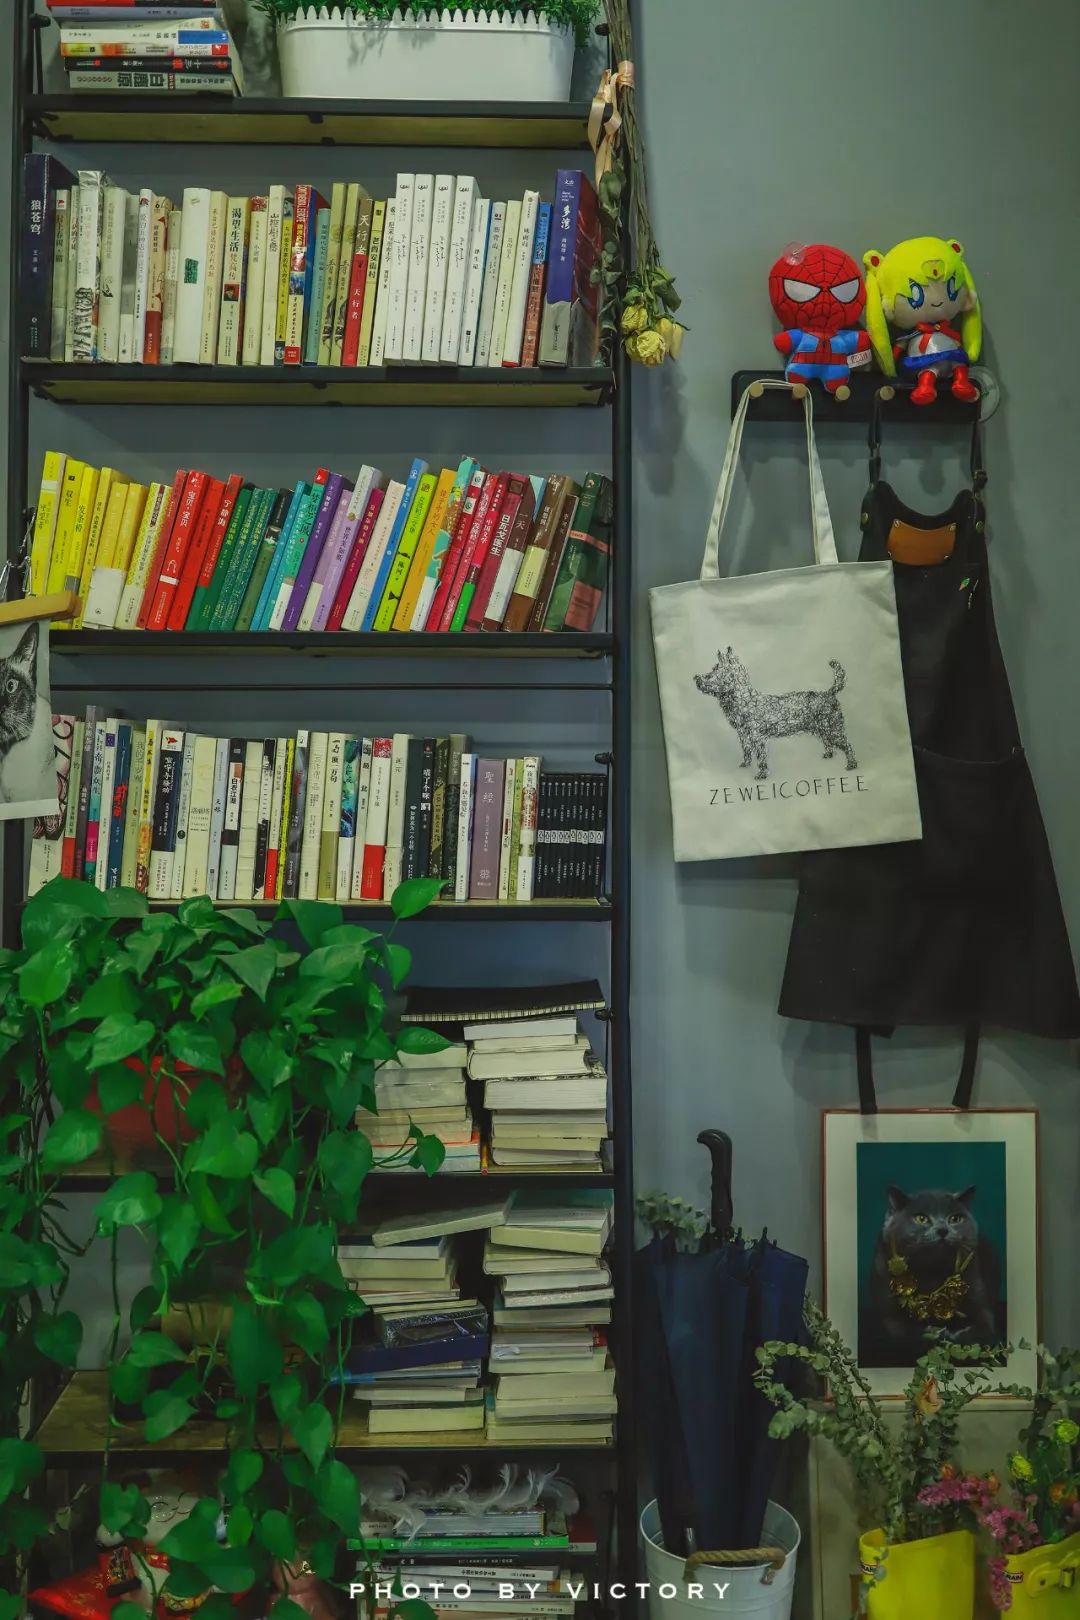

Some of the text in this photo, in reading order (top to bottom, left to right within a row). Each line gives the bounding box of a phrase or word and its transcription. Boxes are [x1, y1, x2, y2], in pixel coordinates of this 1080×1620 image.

[351, 288, 361, 320] 天行者
[489, 514, 511, 556] 日瓦戈医生
[515, 512, 529, 531] 一天
